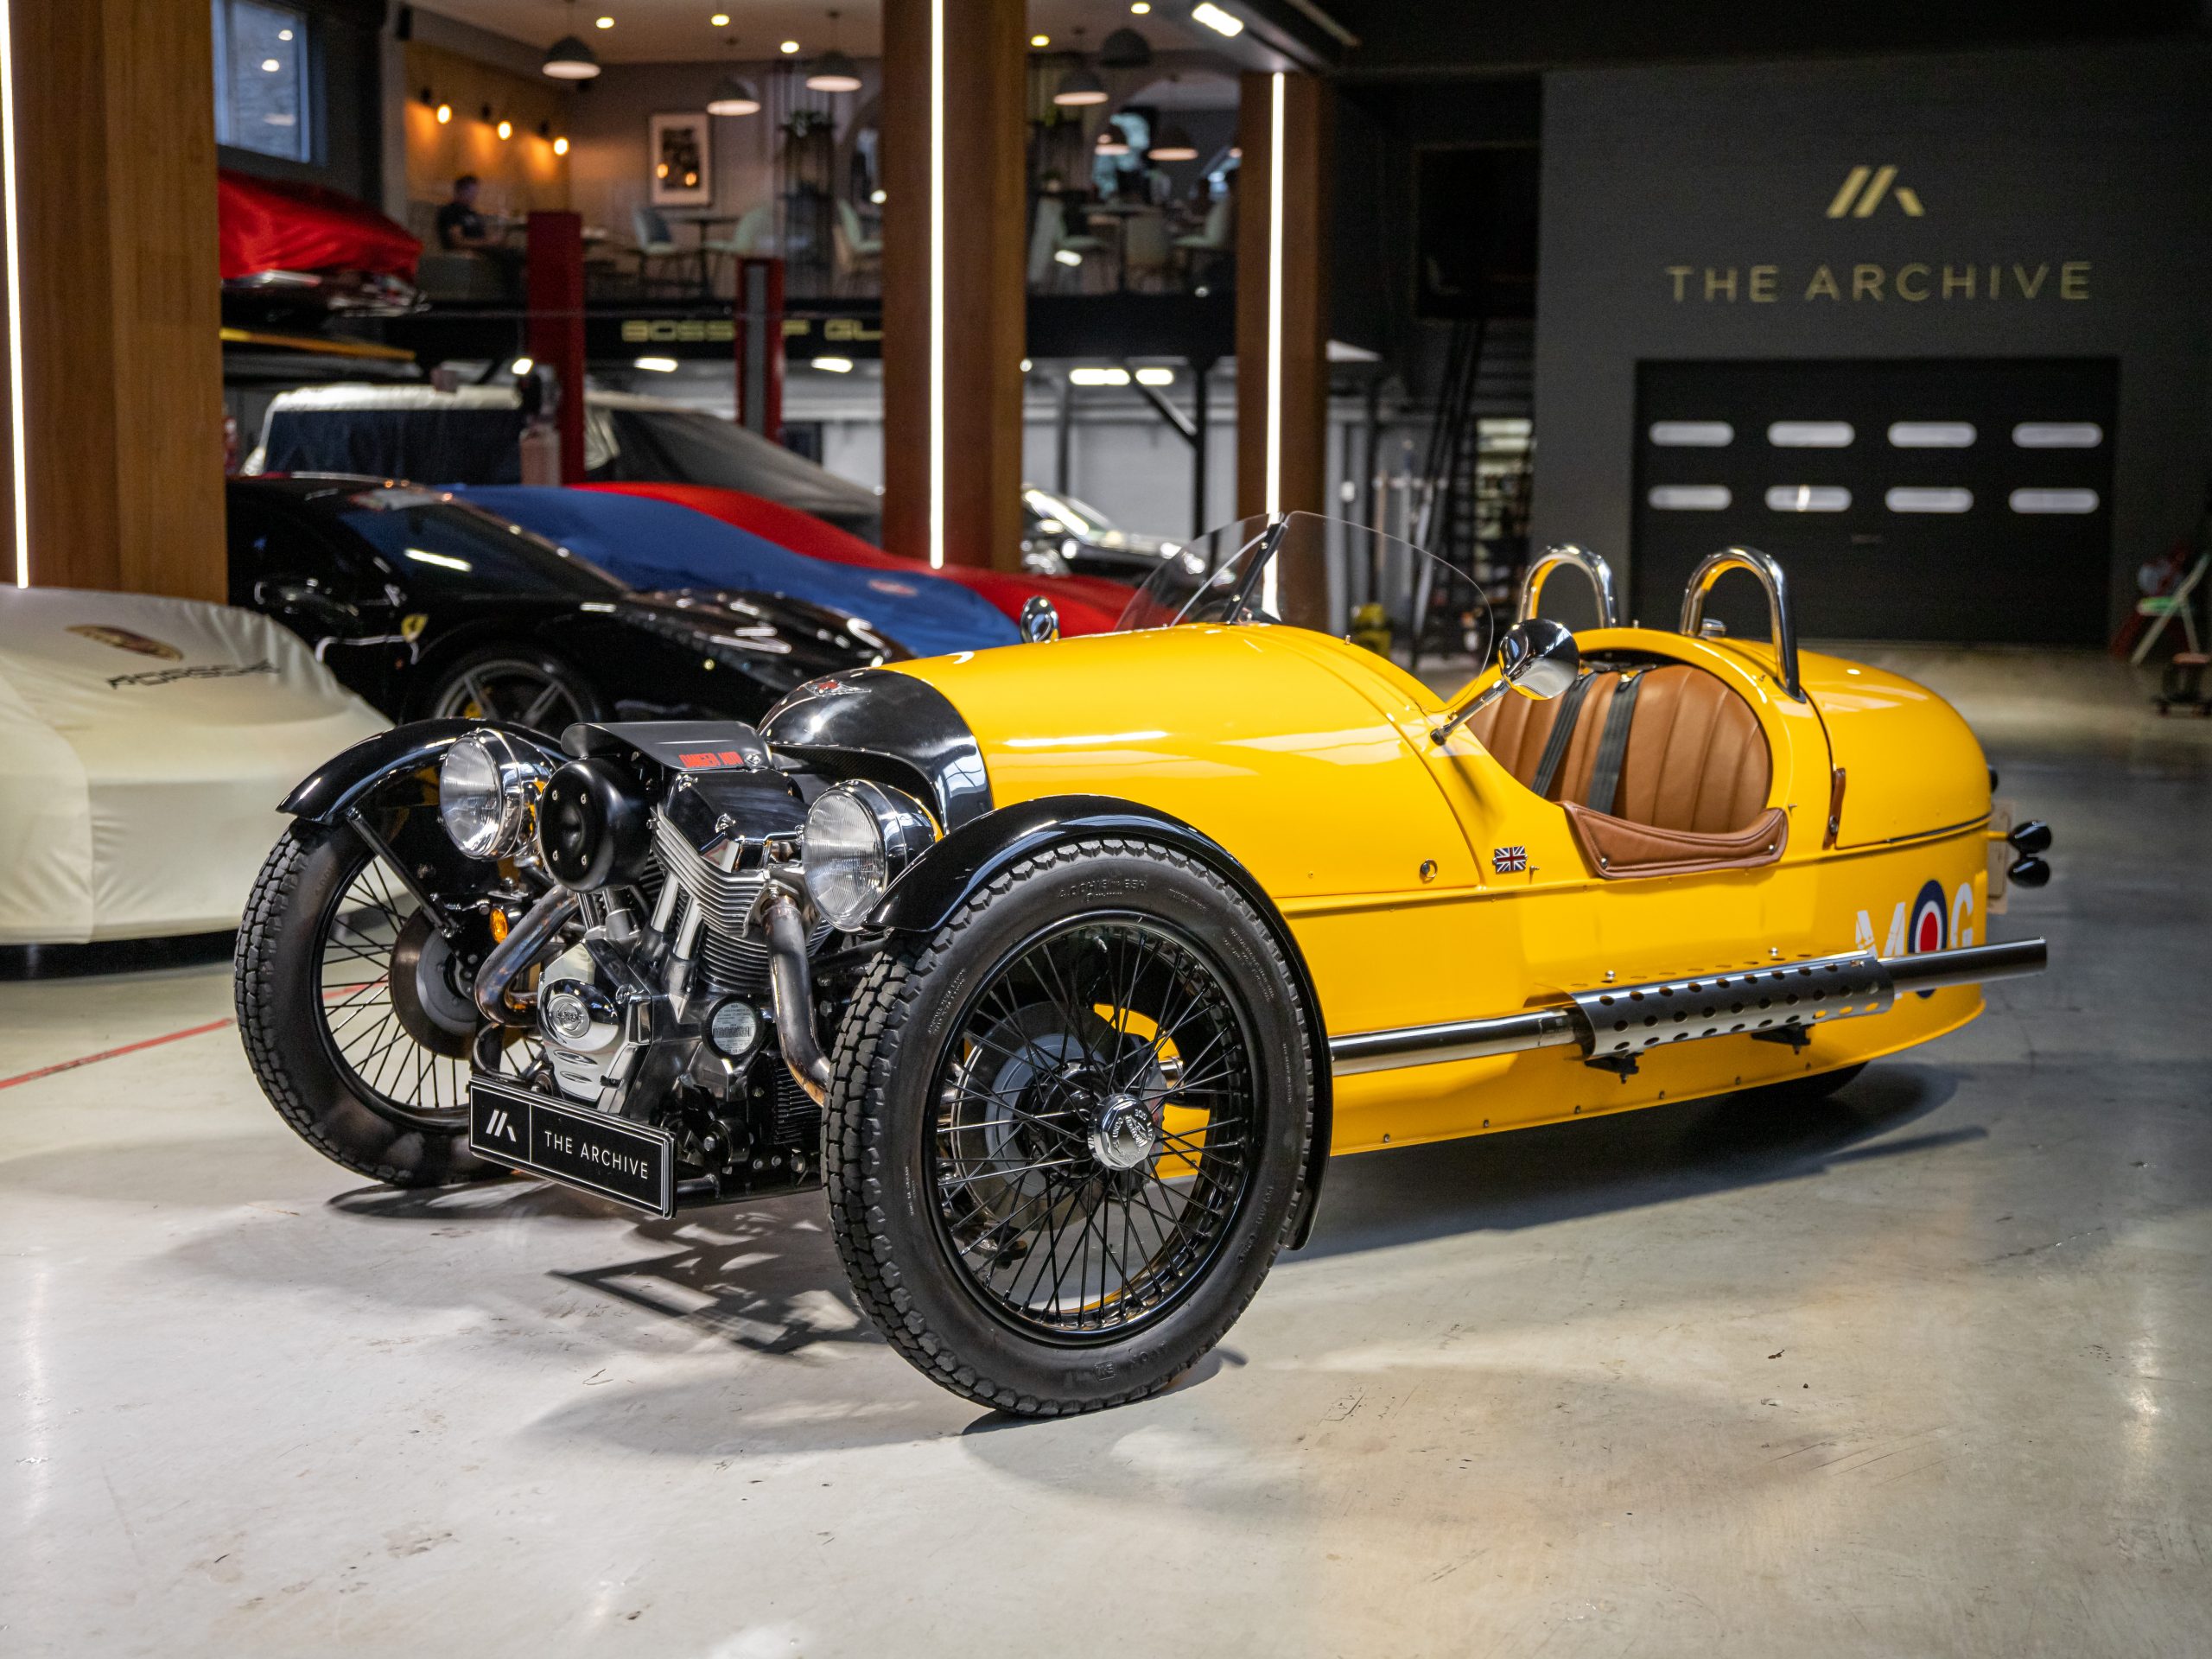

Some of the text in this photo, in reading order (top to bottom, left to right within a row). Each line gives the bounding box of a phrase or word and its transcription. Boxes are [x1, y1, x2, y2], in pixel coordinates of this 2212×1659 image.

[1664, 260, 2093, 302] THE ARCHIVE
[544, 1130, 648, 1179] THE ARCHIVE
